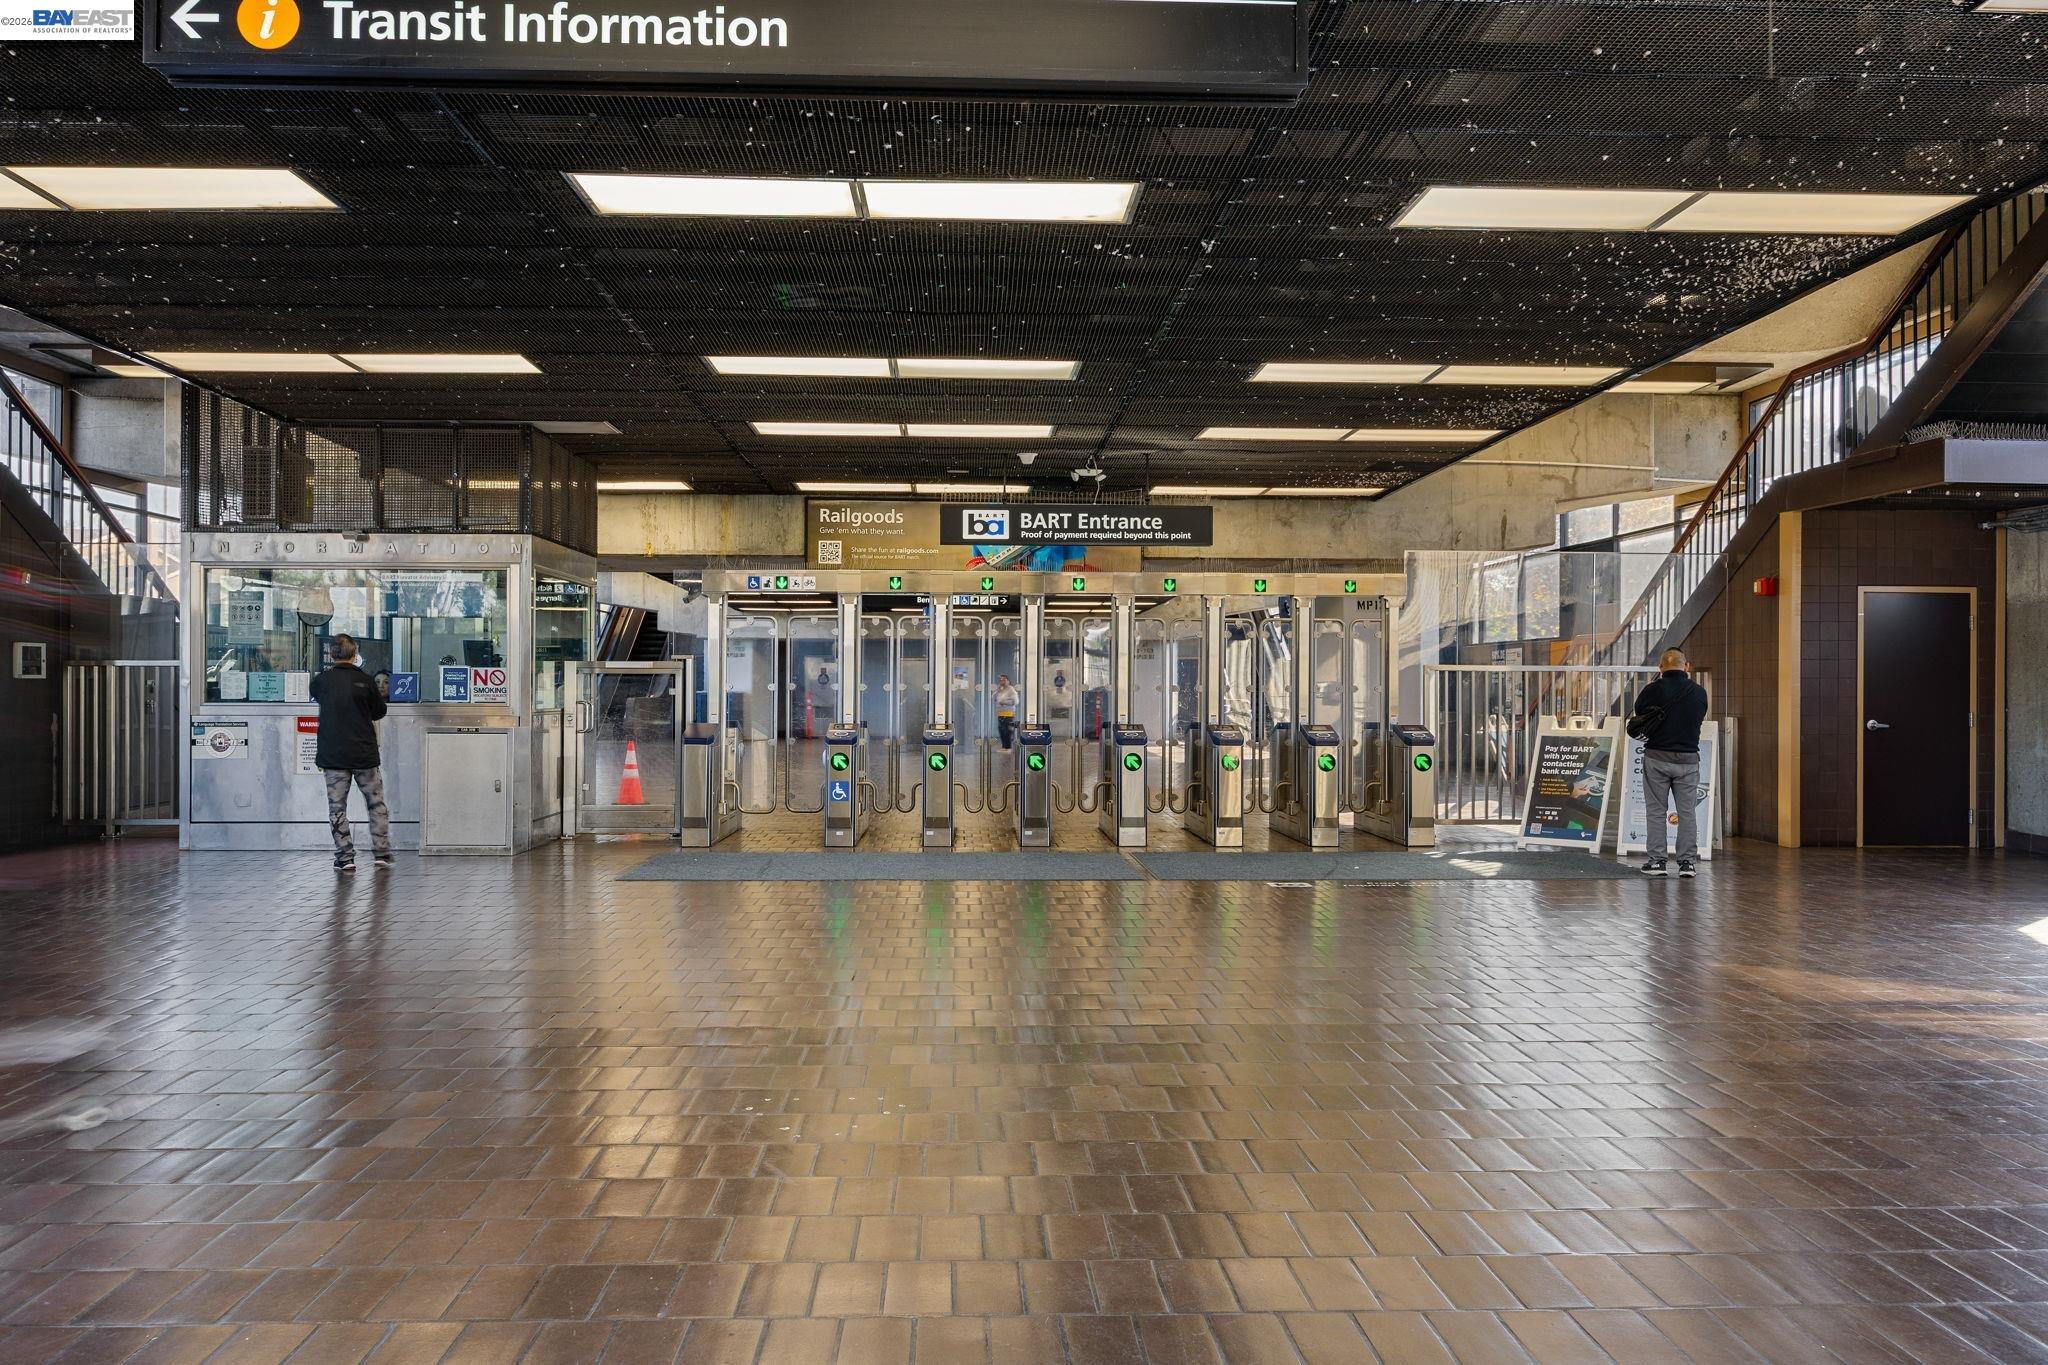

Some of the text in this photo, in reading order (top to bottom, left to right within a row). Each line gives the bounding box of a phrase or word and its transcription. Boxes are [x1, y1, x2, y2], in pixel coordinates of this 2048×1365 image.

[323, 0, 486, 42] Transit
[504, 0, 789, 47] Information
[819, 507, 904, 527] Railgoods
[1020, 512, 1164, 530] BART Entrance
[870, 527, 885, 535] they
[1020, 530, 1192, 541] Proof of payment required beyond this point
[191, 542, 524, 555] INFORMATION
[896, 547, 939, 555] railgoods.com
[473, 686, 508, 694] SMOKING
[1545, 745, 1559, 753] Pay
